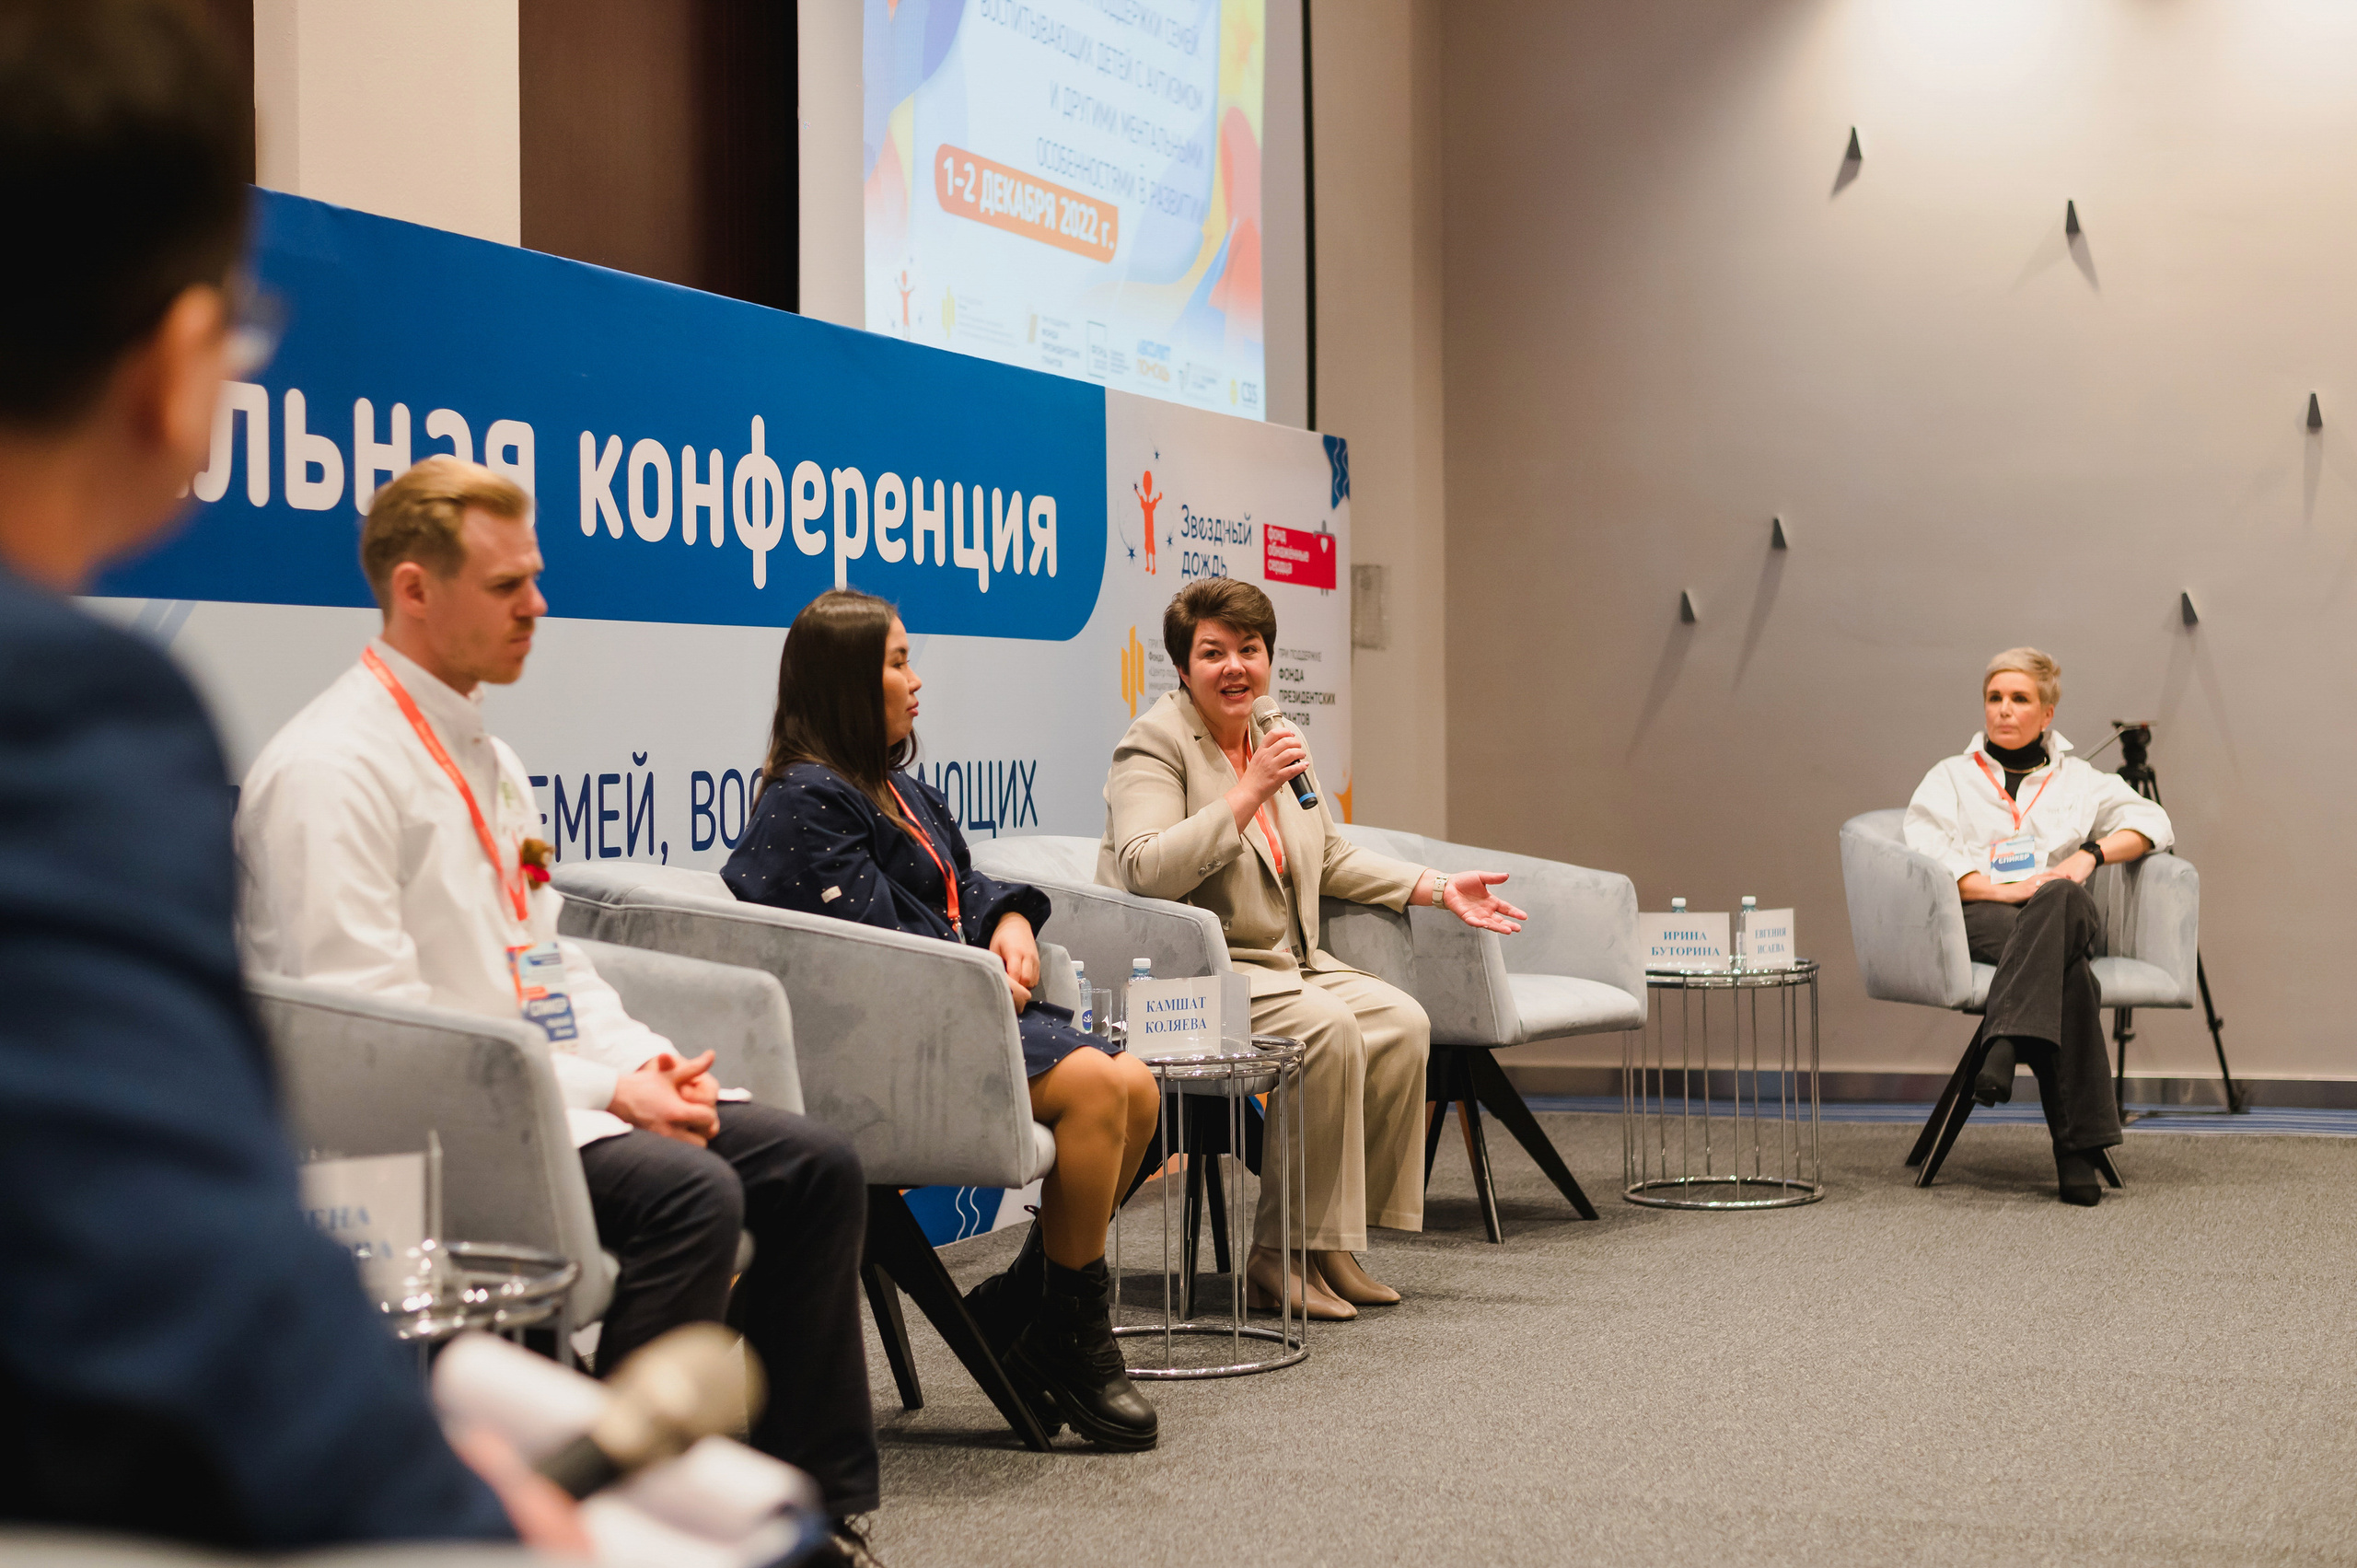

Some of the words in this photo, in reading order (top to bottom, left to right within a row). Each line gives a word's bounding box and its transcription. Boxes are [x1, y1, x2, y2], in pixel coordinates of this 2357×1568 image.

[1037, 136, 1135, 200] ОСОБЕННОСТЯМИ
[943, 157, 976, 203] 1-2
[980, 168, 1057, 230] ДЕКАБРЯ
[1060, 196, 1098, 245] 2022
[579, 414, 1058, 593] конференция
[1180, 504, 1252, 547] Звездный
[1181, 551, 1228, 579] дождь
[1279, 668, 1305, 684] ФОНДА
[1279, 689, 1336, 706] ПРЕЗИДЕНТСКИХ
[1282, 711, 1310, 726] РАНТОВ
[1664, 931, 1707, 941] ИРИНА
[1755, 927, 1787, 939] ЕВГЕНИЯ
[1652, 947, 1721, 957] БУТОРИНА
[1757, 944, 1785, 955] ИСАЕВА
[1146, 996, 1207, 1013] КАМШАТ
[1145, 1017, 1207, 1034] КОЛЯЕВА
